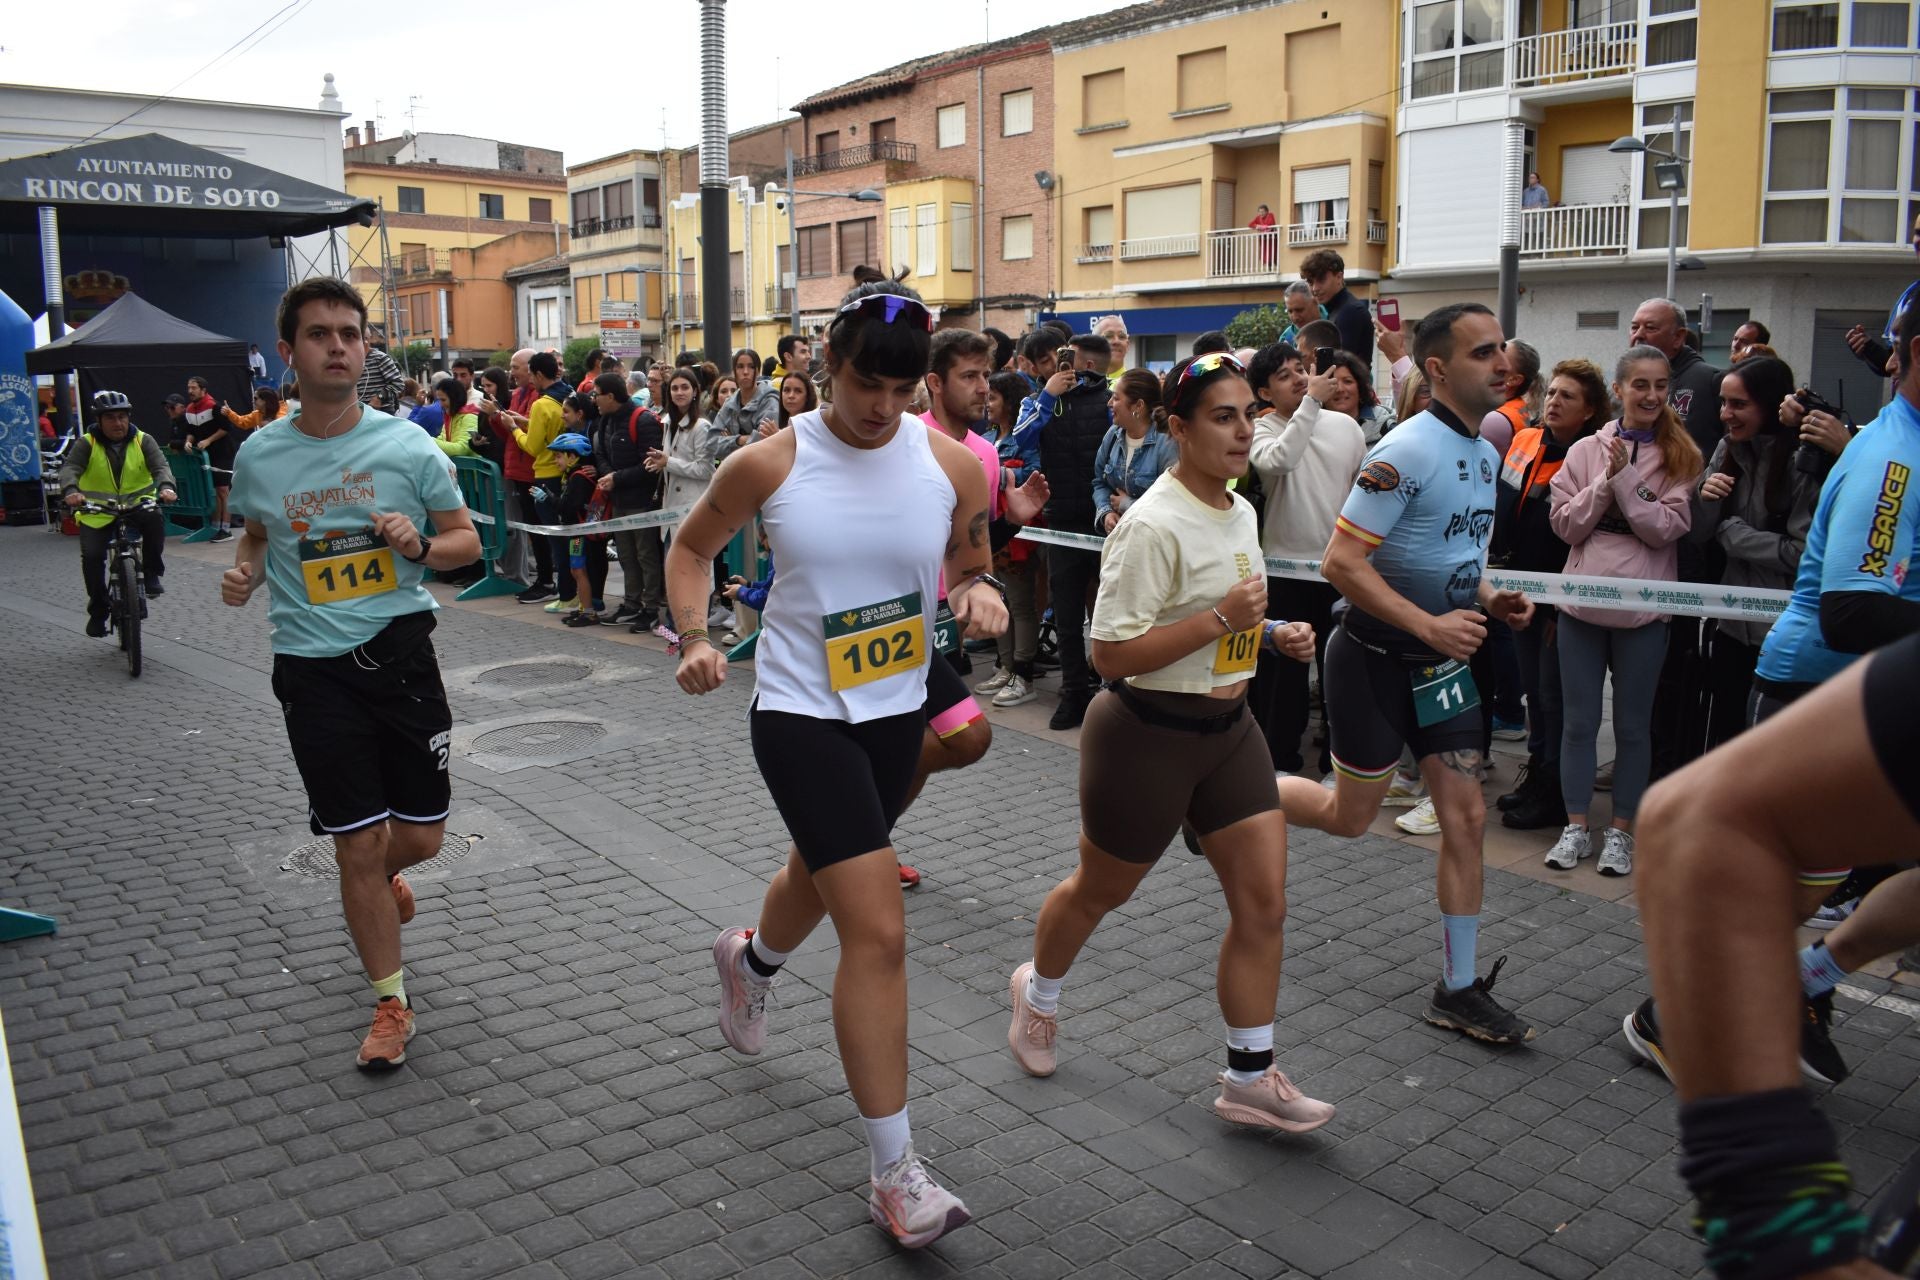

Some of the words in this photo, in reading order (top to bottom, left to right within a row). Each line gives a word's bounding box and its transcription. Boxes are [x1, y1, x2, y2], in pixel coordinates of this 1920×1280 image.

[77, 158, 233, 180] AYUNTAMIENTO
[25, 177, 142, 203] RINCON
[153, 184, 193, 205] DE
[204, 187, 281, 208] SOTO
[300, 485, 375, 506] DUATLÓN
[286, 503, 325, 520] CROS
[1858, 460, 1910, 578] X-SAUCE
[343, 540, 373, 549] NAVARRA
[318, 558, 384, 592] 114
[1590, 591, 1622, 600] NAVARRA
[1669, 597, 1704, 606] NAVARRA
[1676, 591, 1700, 600] RURAL
[861, 608, 878, 617] CAJA
[879, 601, 902, 613] RURAL
[862, 615, 872, 624] DE
[874, 607, 906, 621] NAVARRA
[1755, 605, 1787, 613] NAVARR
[843, 630, 914, 674] 102
[1226, 631, 1256, 661] 101
[1436, 681, 1464, 710] 11
[428, 730, 452, 752] CHIC
